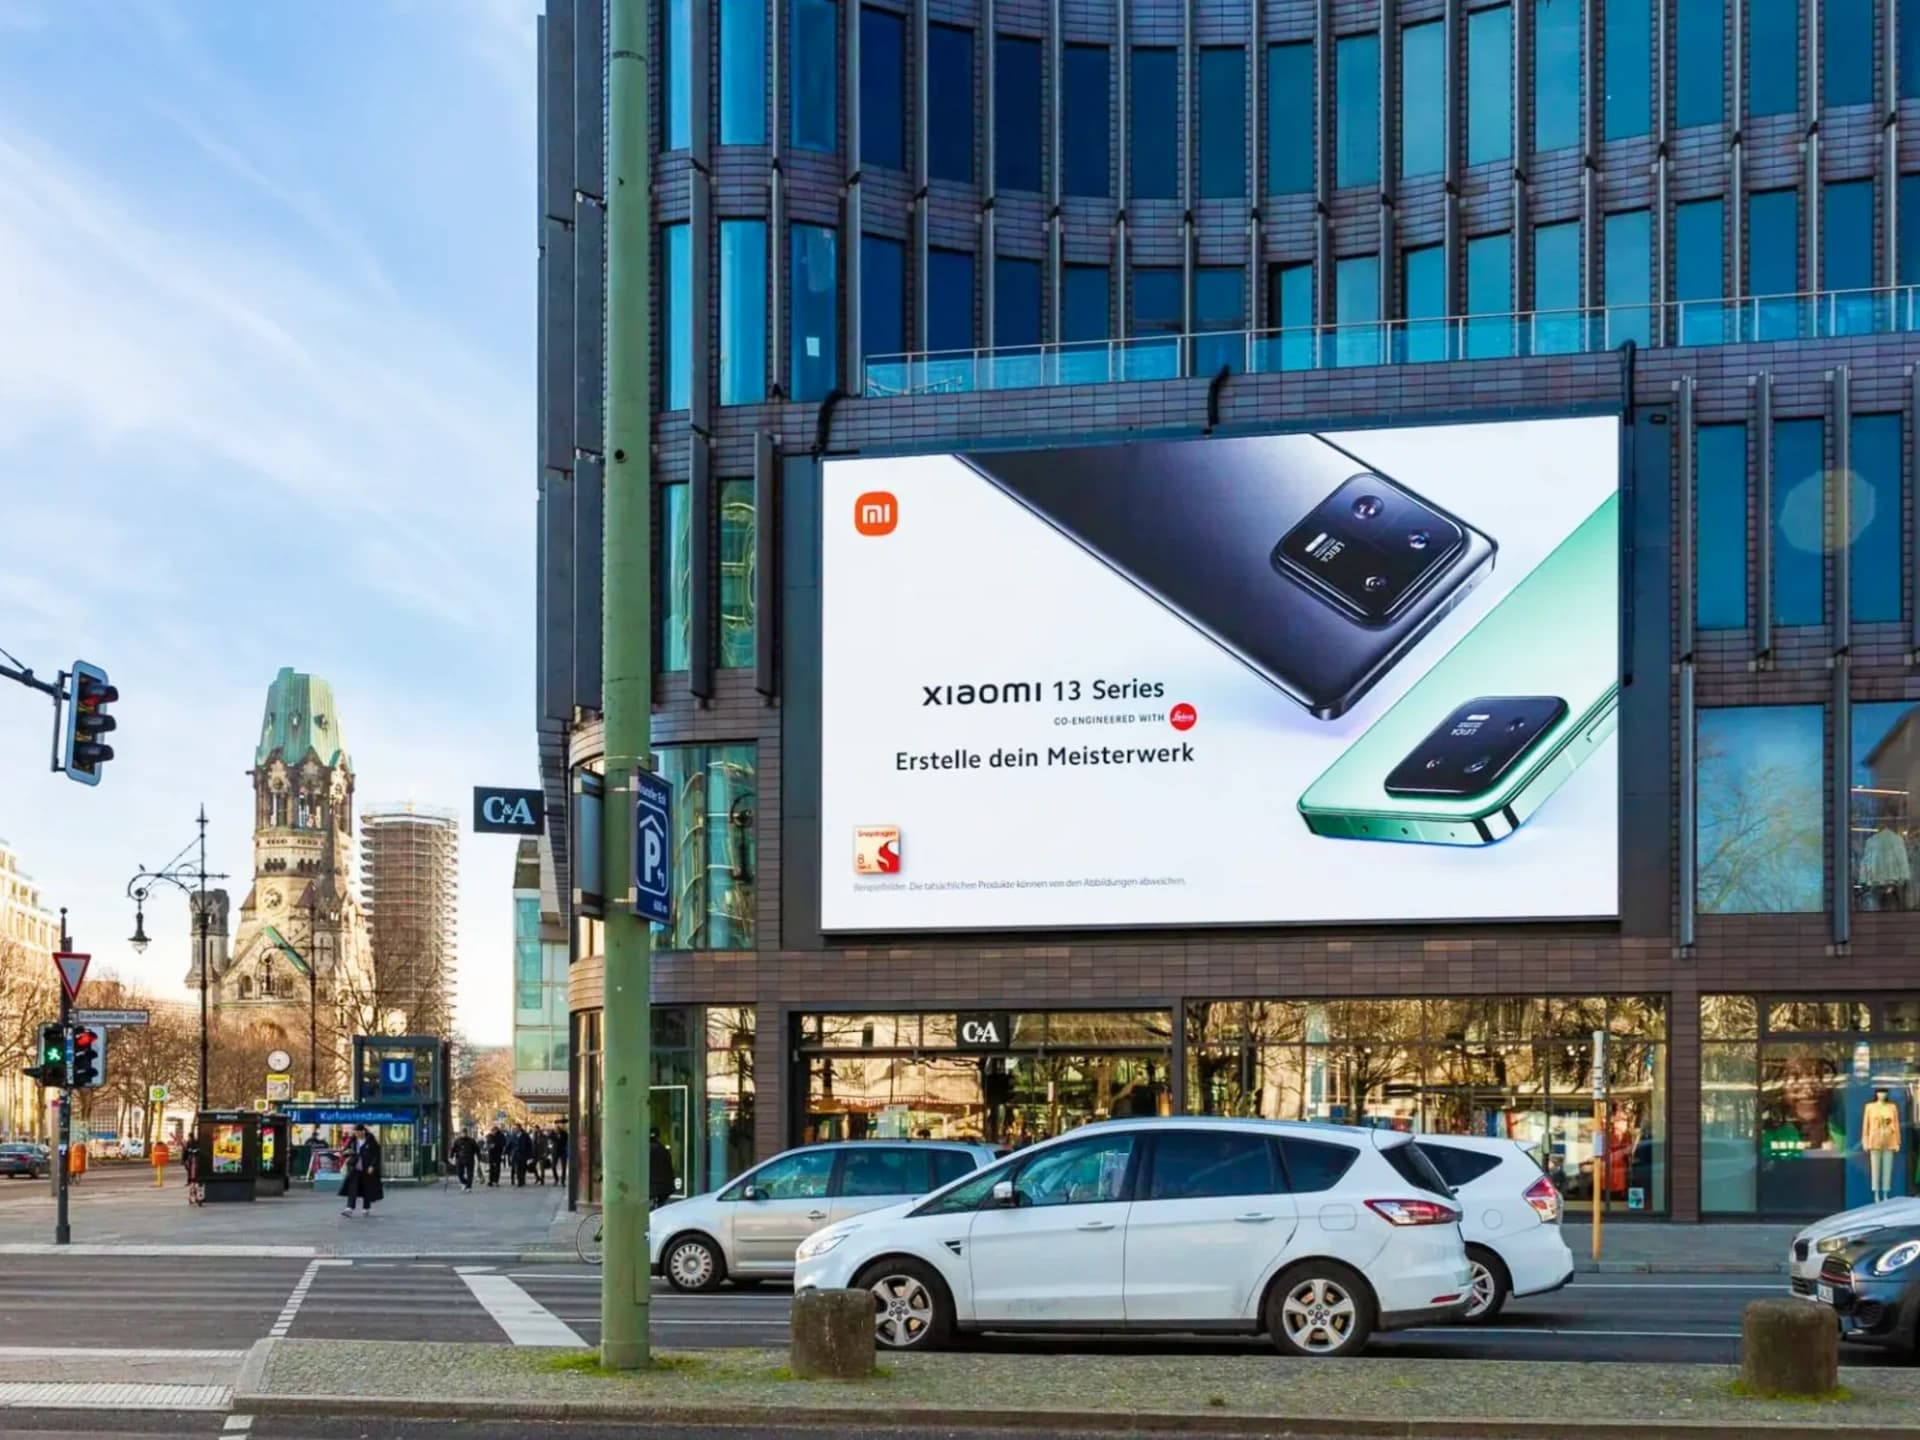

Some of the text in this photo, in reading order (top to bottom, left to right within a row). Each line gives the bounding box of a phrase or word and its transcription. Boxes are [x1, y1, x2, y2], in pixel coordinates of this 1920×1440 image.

[1053, 680, 1081, 701] 13
[1092, 678, 1164, 700] Series
[1054, 713, 1165, 726] CO-ENGINEERED WITH
[896, 742, 1195, 770] Erstelle dein Meisterwerk
[483, 796, 536, 825] C&A
[644, 828, 661, 882] P
[962, 1021, 1000, 1043] C&A
[389, 1062, 407, 1082] U
